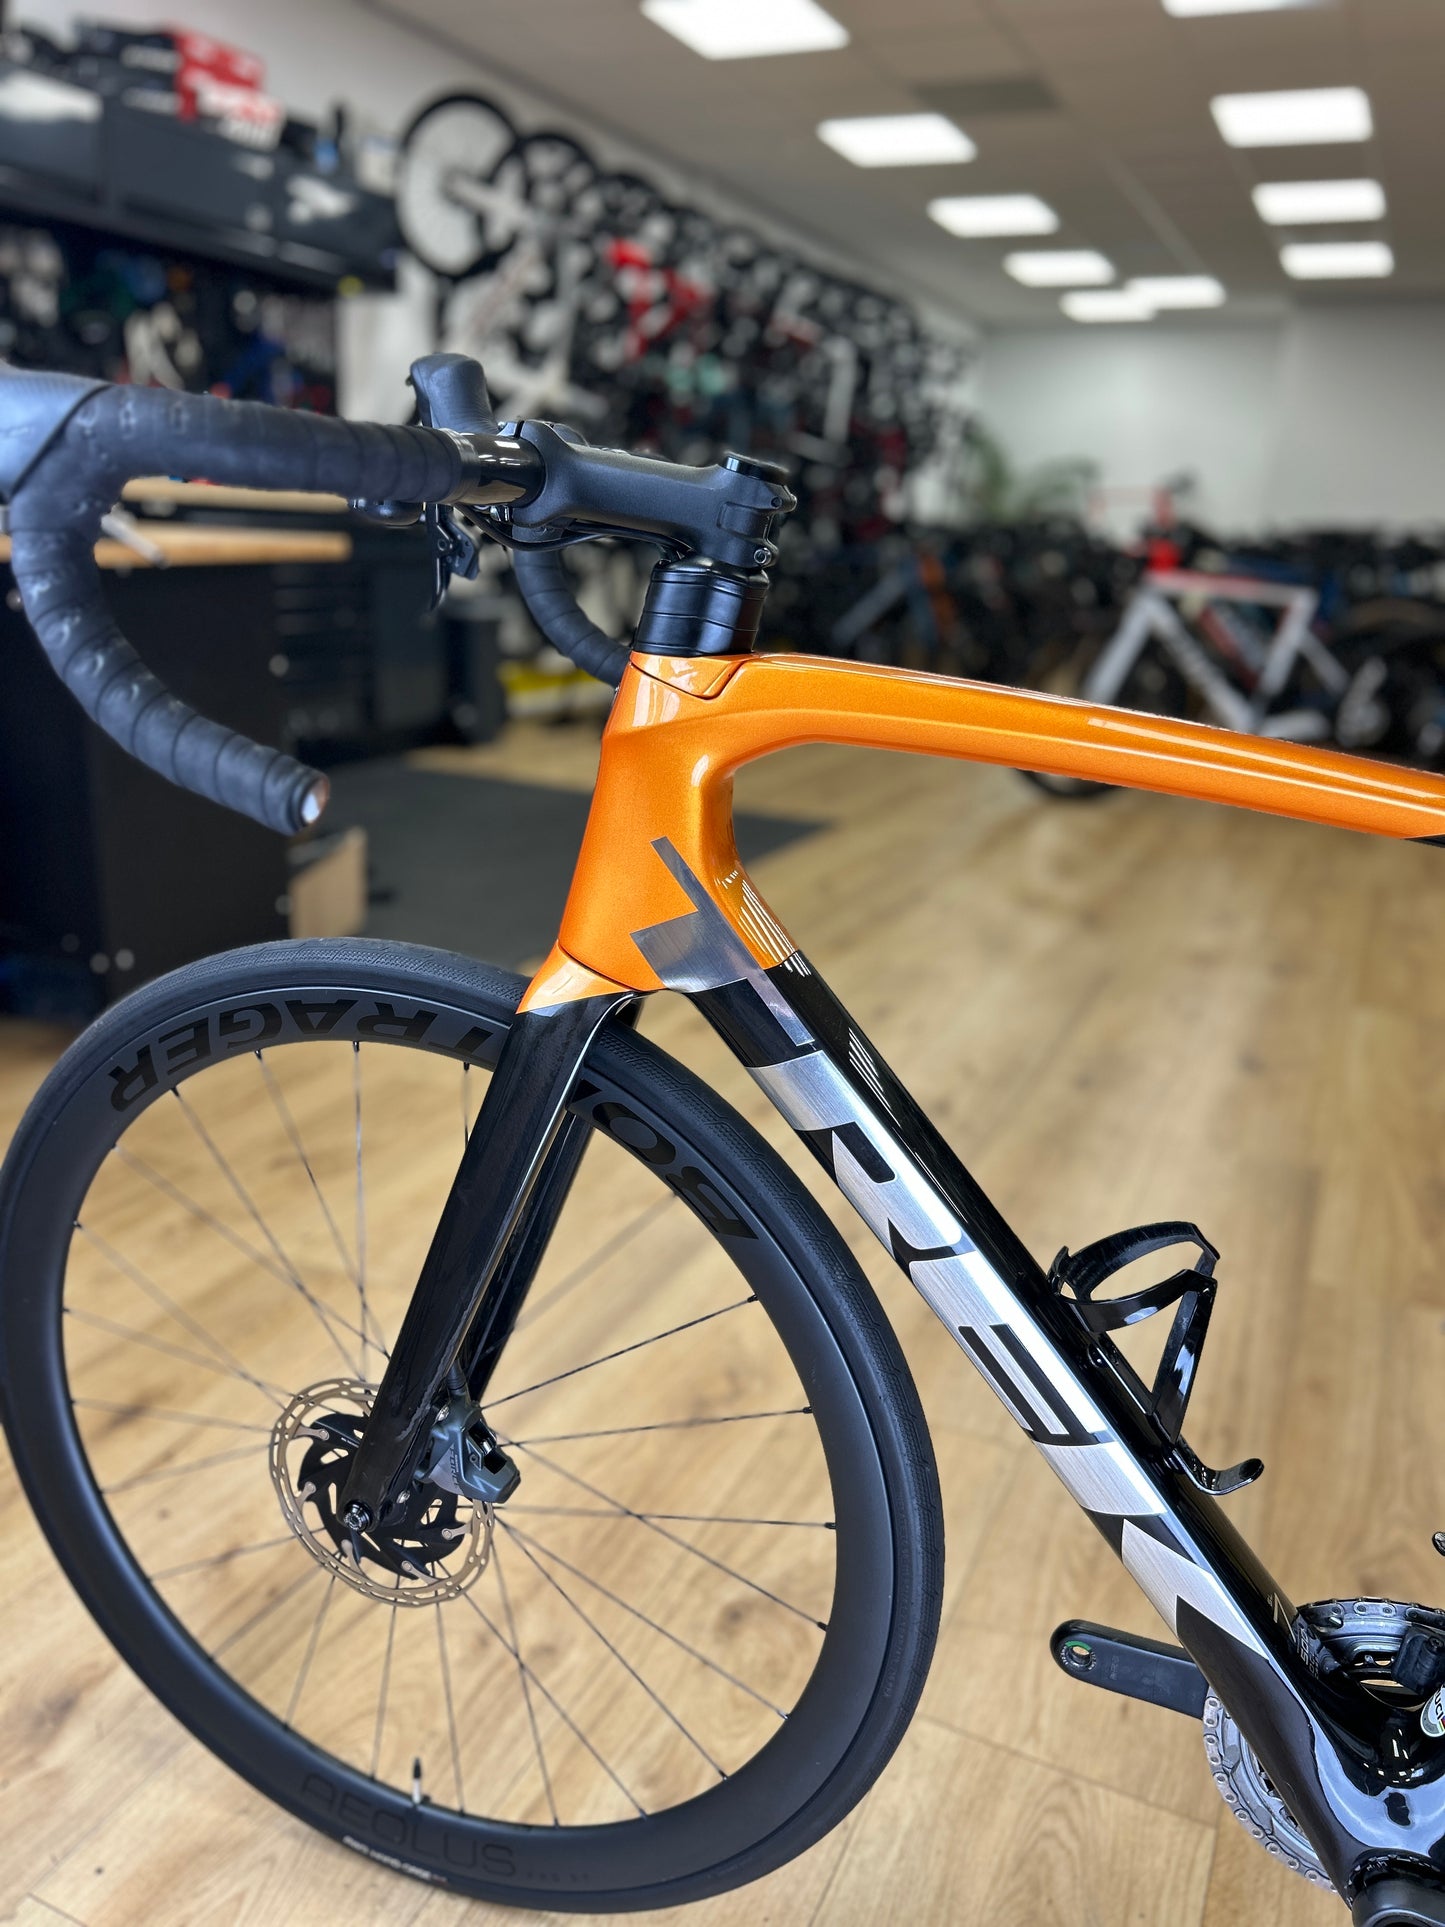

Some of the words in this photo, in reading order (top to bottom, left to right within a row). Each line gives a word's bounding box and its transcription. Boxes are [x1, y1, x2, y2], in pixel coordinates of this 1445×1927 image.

[629, 836, 1267, 1661] TREK
[1432, 1690, 1445, 1721] UCI
[302, 1772, 517, 1878] AEOLUS
